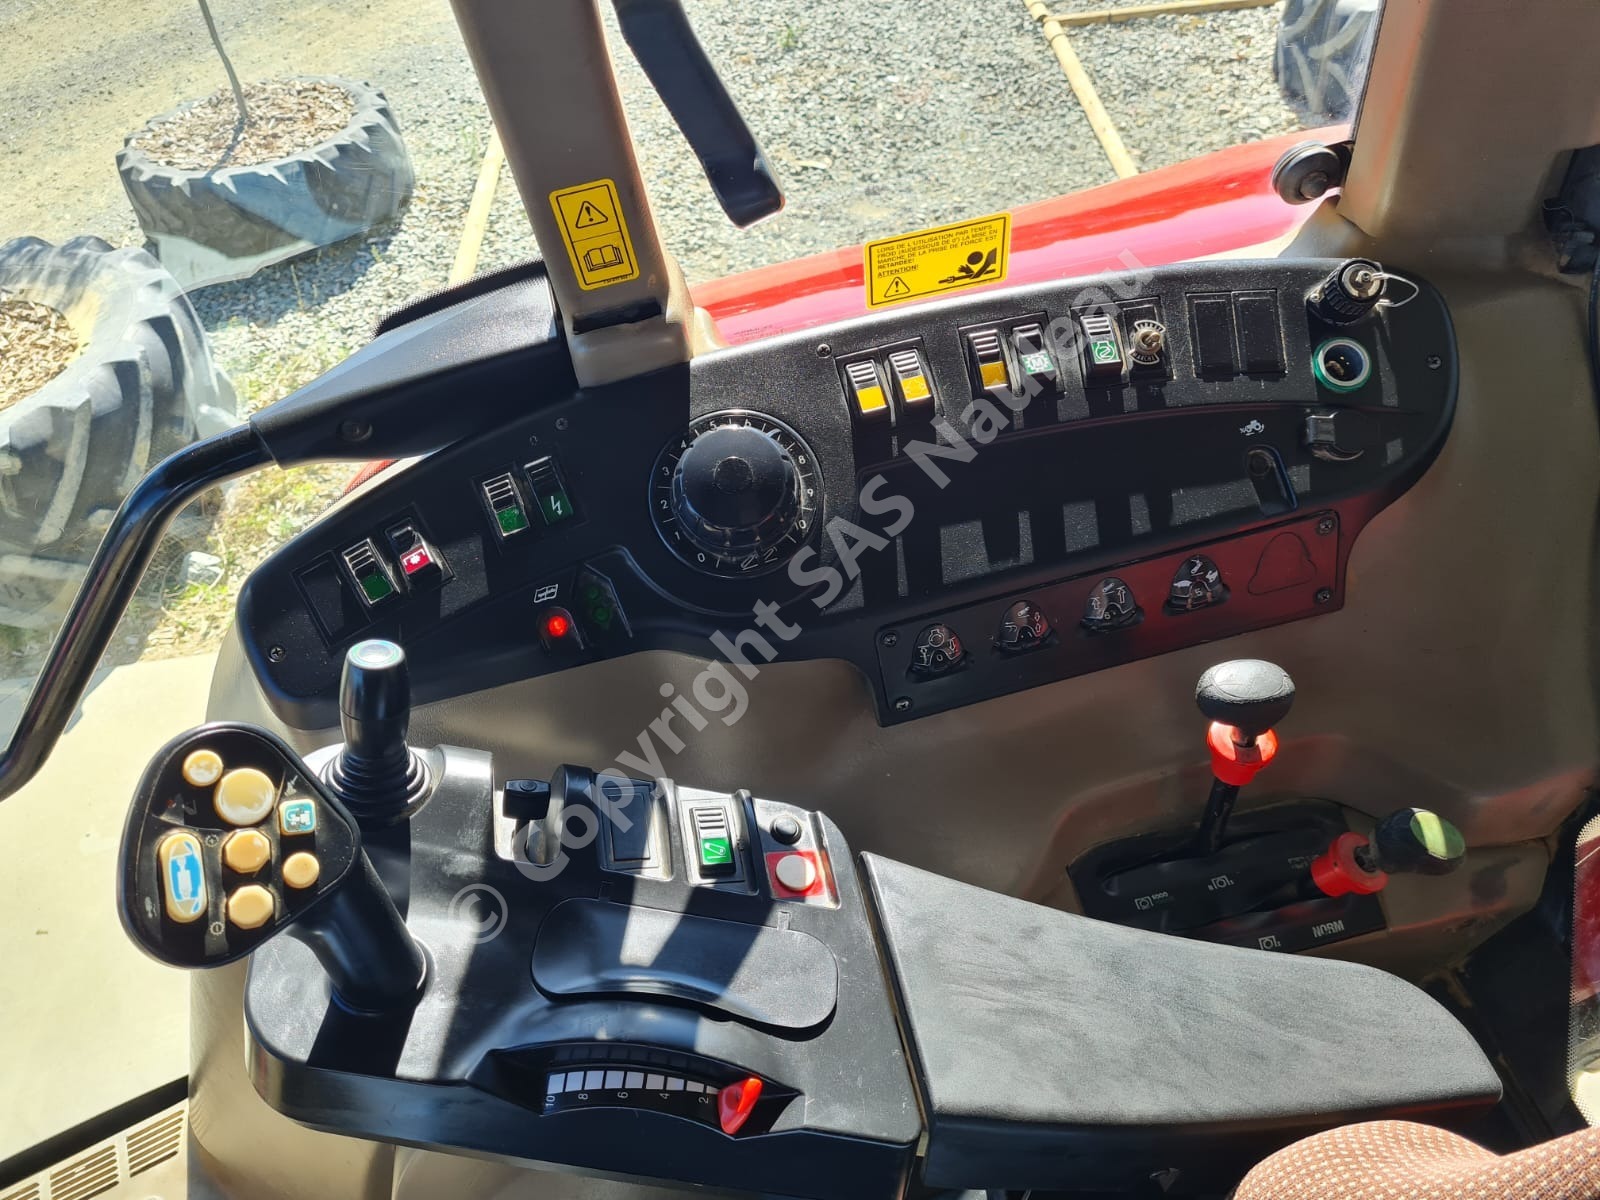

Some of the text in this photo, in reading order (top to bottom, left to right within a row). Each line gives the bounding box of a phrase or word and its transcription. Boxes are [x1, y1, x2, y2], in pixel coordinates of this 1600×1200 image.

[877, 245, 894, 253] LORS
[971, 225, 992, 233] TEMPS
[877, 251, 896, 259] FROID
[878, 255, 905, 265] MARCHE
[960, 239, 982, 247] FORCE
[878, 264, 918, 278] ATTENTION!
[709, 421, 718, 431] 5
[681, 440, 687, 449] 4
[799, 455, 806, 464] 8
[662, 467, 670, 476] 3
[806, 488, 814, 497] 9
[660, 500, 669, 509] 2
[795, 520, 807, 530] 10
[675, 532, 681, 541] 1
[697, 553, 706, 563] 0
[1312, 920, 1344, 938] NORM
[617, 1091, 628, 1099] 6
[659, 1092, 670, 1100] 4
[545, 1095, 556, 1107] 10
[698, 1096, 709, 1104] 2
